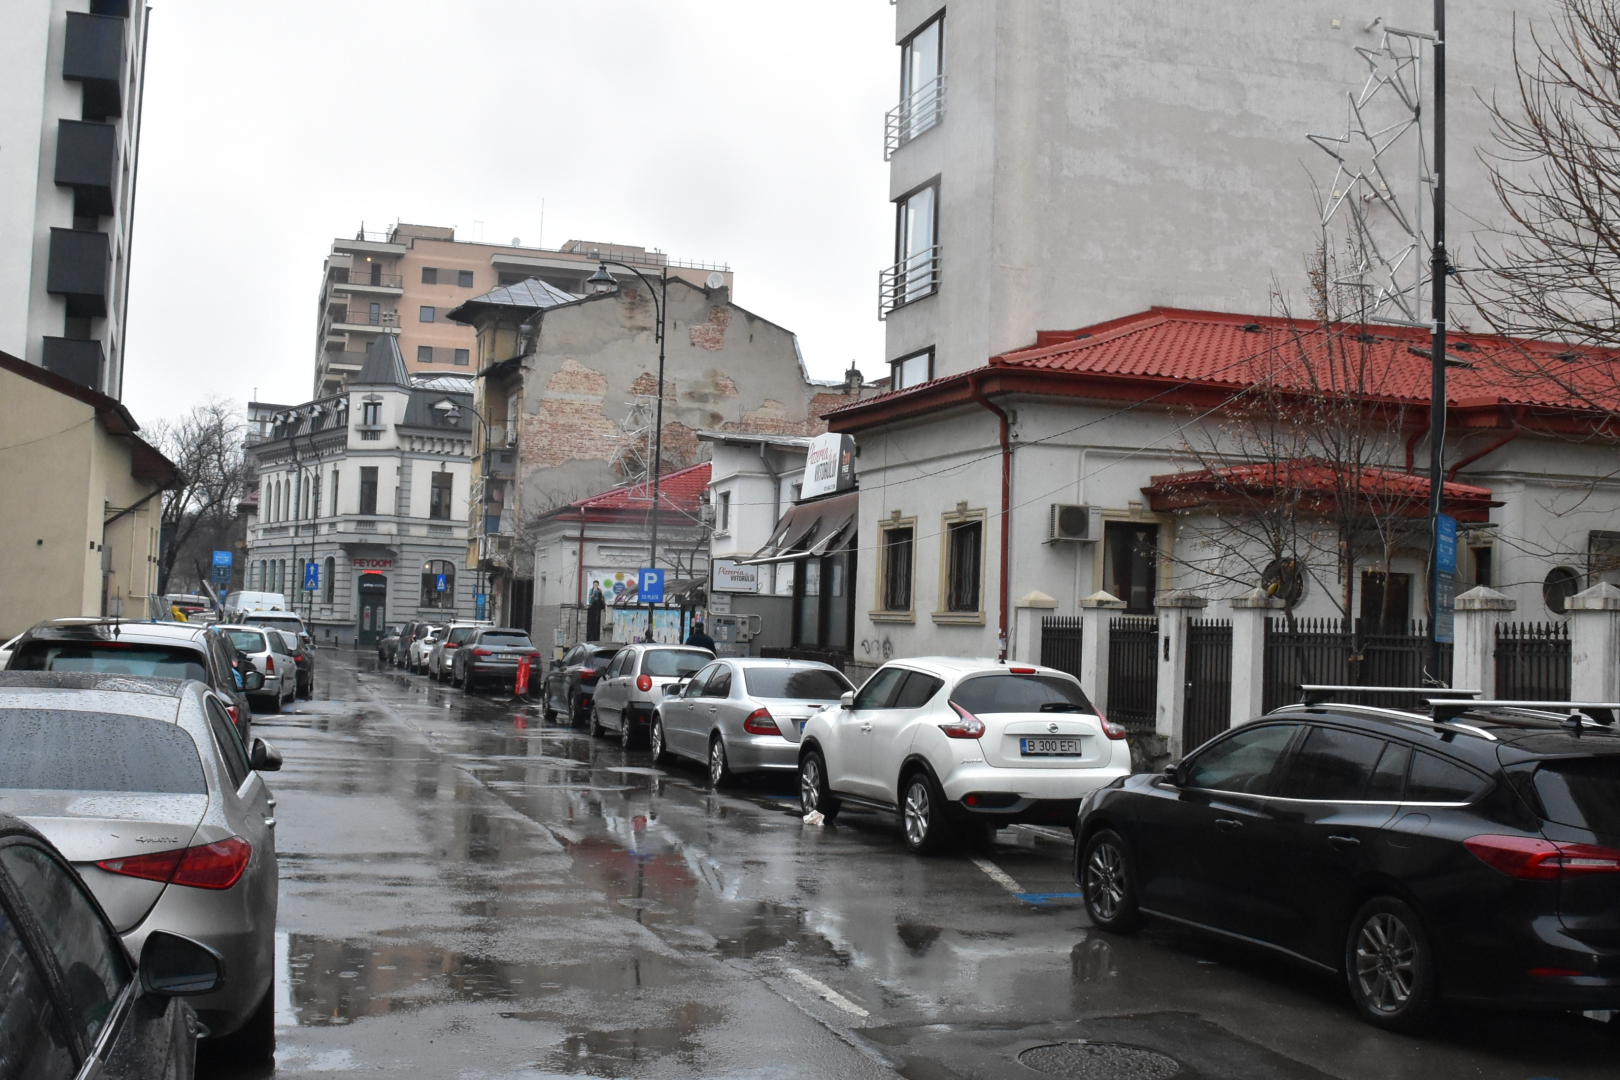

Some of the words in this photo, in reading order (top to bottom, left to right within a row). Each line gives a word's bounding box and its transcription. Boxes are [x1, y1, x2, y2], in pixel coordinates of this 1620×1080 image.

[353, 558, 392, 568] FEYDOM
[718, 566, 744, 576] Pizzeria
[644, 572, 658, 591] P
[1028, 740, 1035, 751] B
[1039, 740, 1057, 752] 300
[1060, 740, 1077, 752] EFI
[136, 835, 178, 843] 4MATIC
